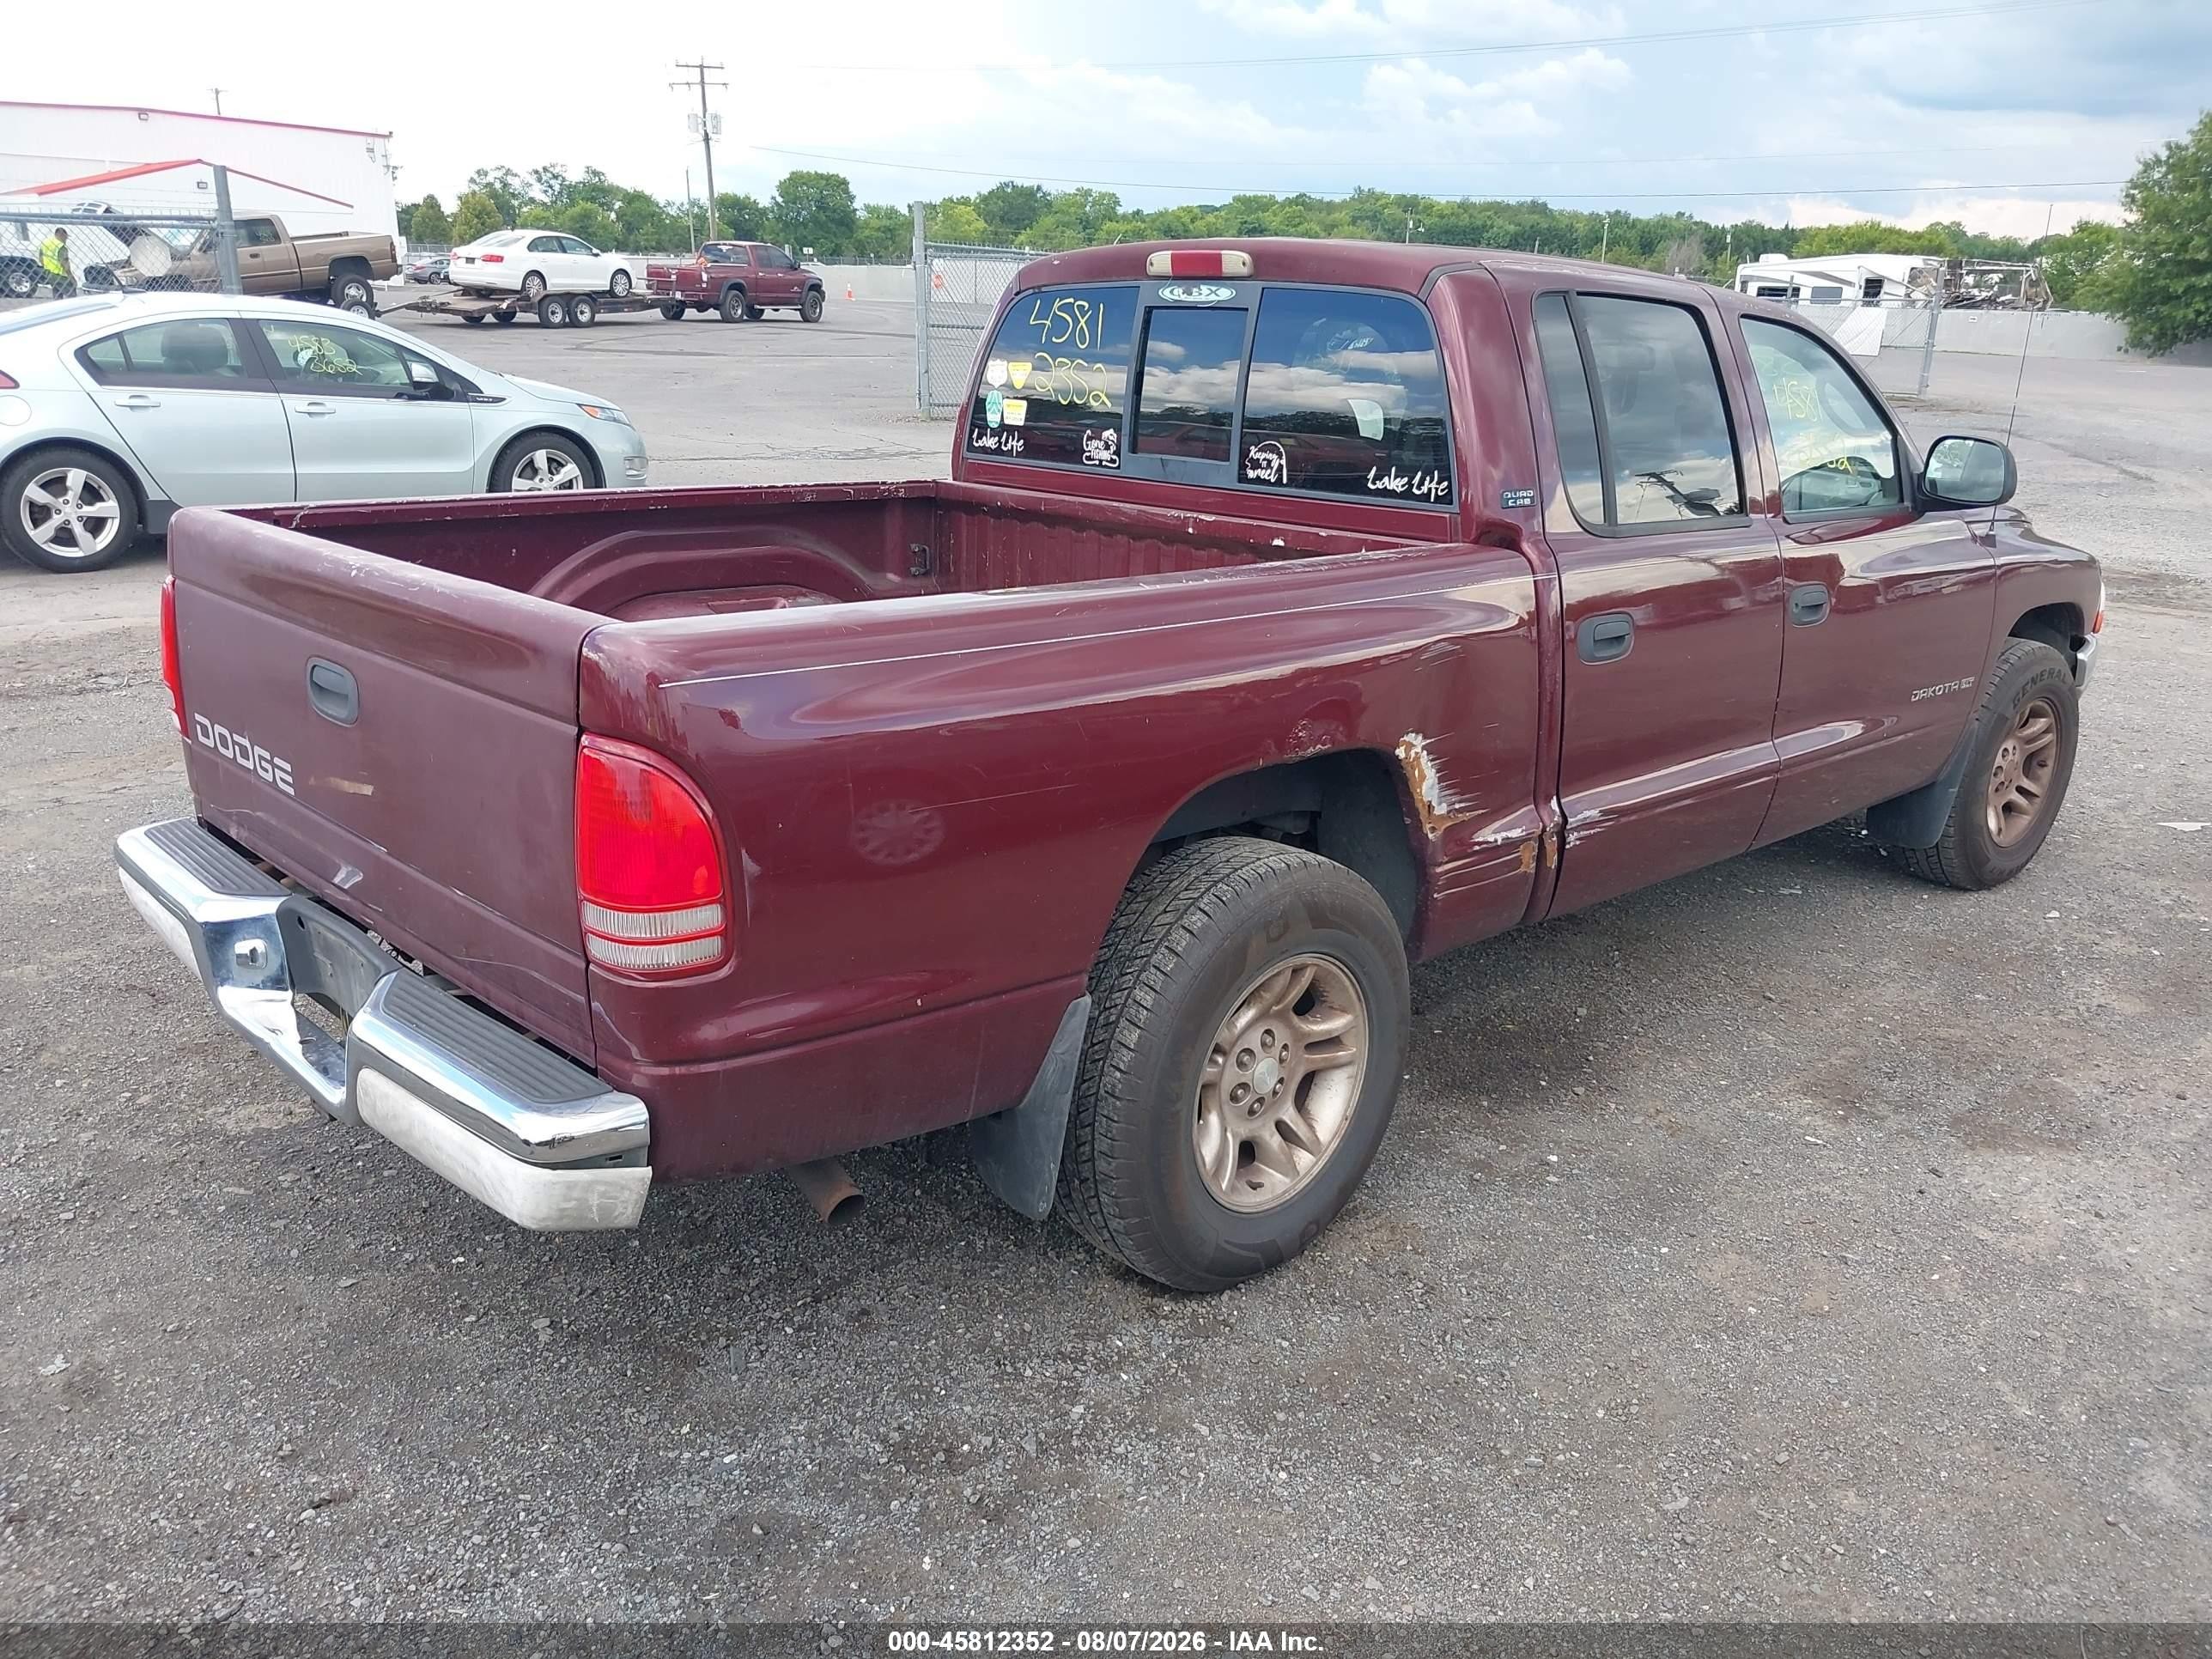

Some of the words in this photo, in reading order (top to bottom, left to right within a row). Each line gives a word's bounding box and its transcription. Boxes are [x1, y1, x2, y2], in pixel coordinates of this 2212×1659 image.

[1030, 297, 1103, 351] 4581
[1034, 352, 1112, 410] 2352
[1772, 378, 1822, 422] 4581
[972, 428, 999, 450] Lake
[1083, 429, 1105, 451] Gone
[1249, 446, 1279, 467] Keeping
[1366, 465, 1408, 494] Lake
[1503, 490, 1534, 499] QUAD
[1911, 680, 1960, 702] DAKOTA
[2012, 667, 2068, 710] GENERAL
[193, 712, 295, 797] DODGE
